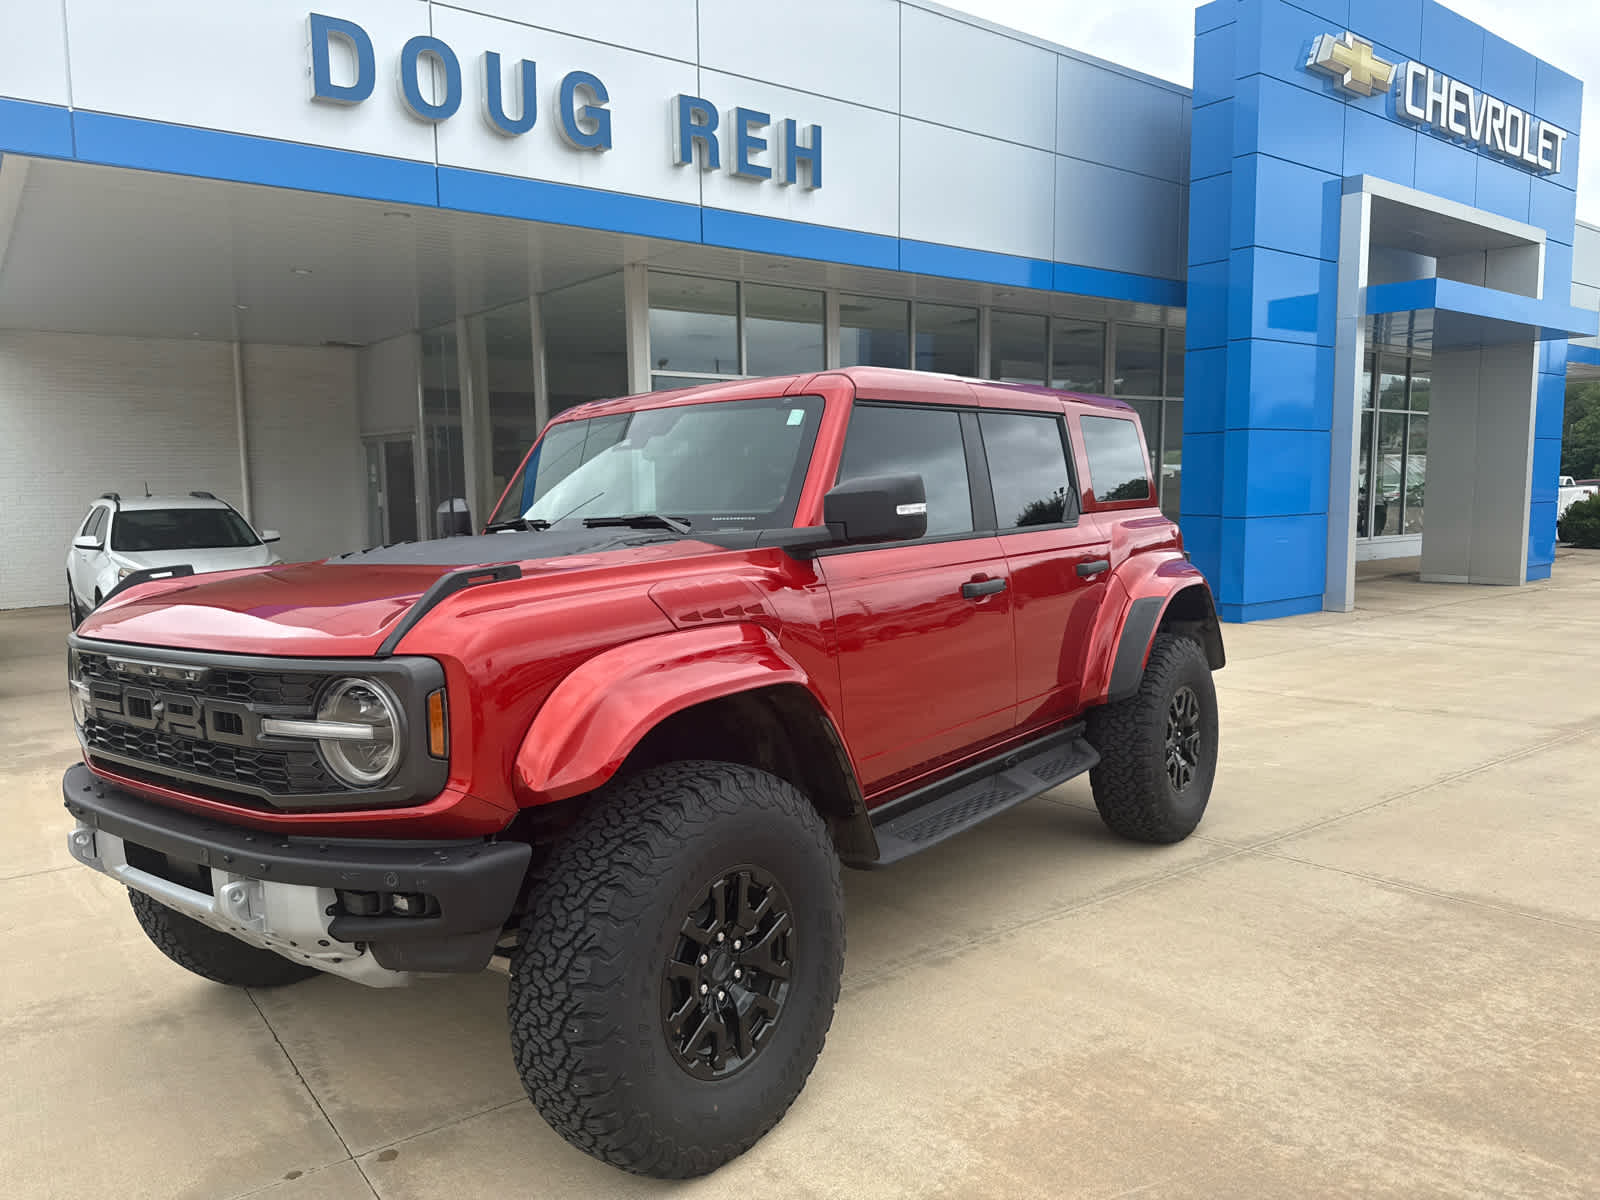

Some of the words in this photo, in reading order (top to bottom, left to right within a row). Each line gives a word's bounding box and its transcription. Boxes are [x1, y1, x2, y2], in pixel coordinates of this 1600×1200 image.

[307, 12, 612, 152] DOUG
[673, 93, 822, 190] REH
[1401, 60, 1567, 174] CHEVROLET
[89, 679, 257, 747] FORD
